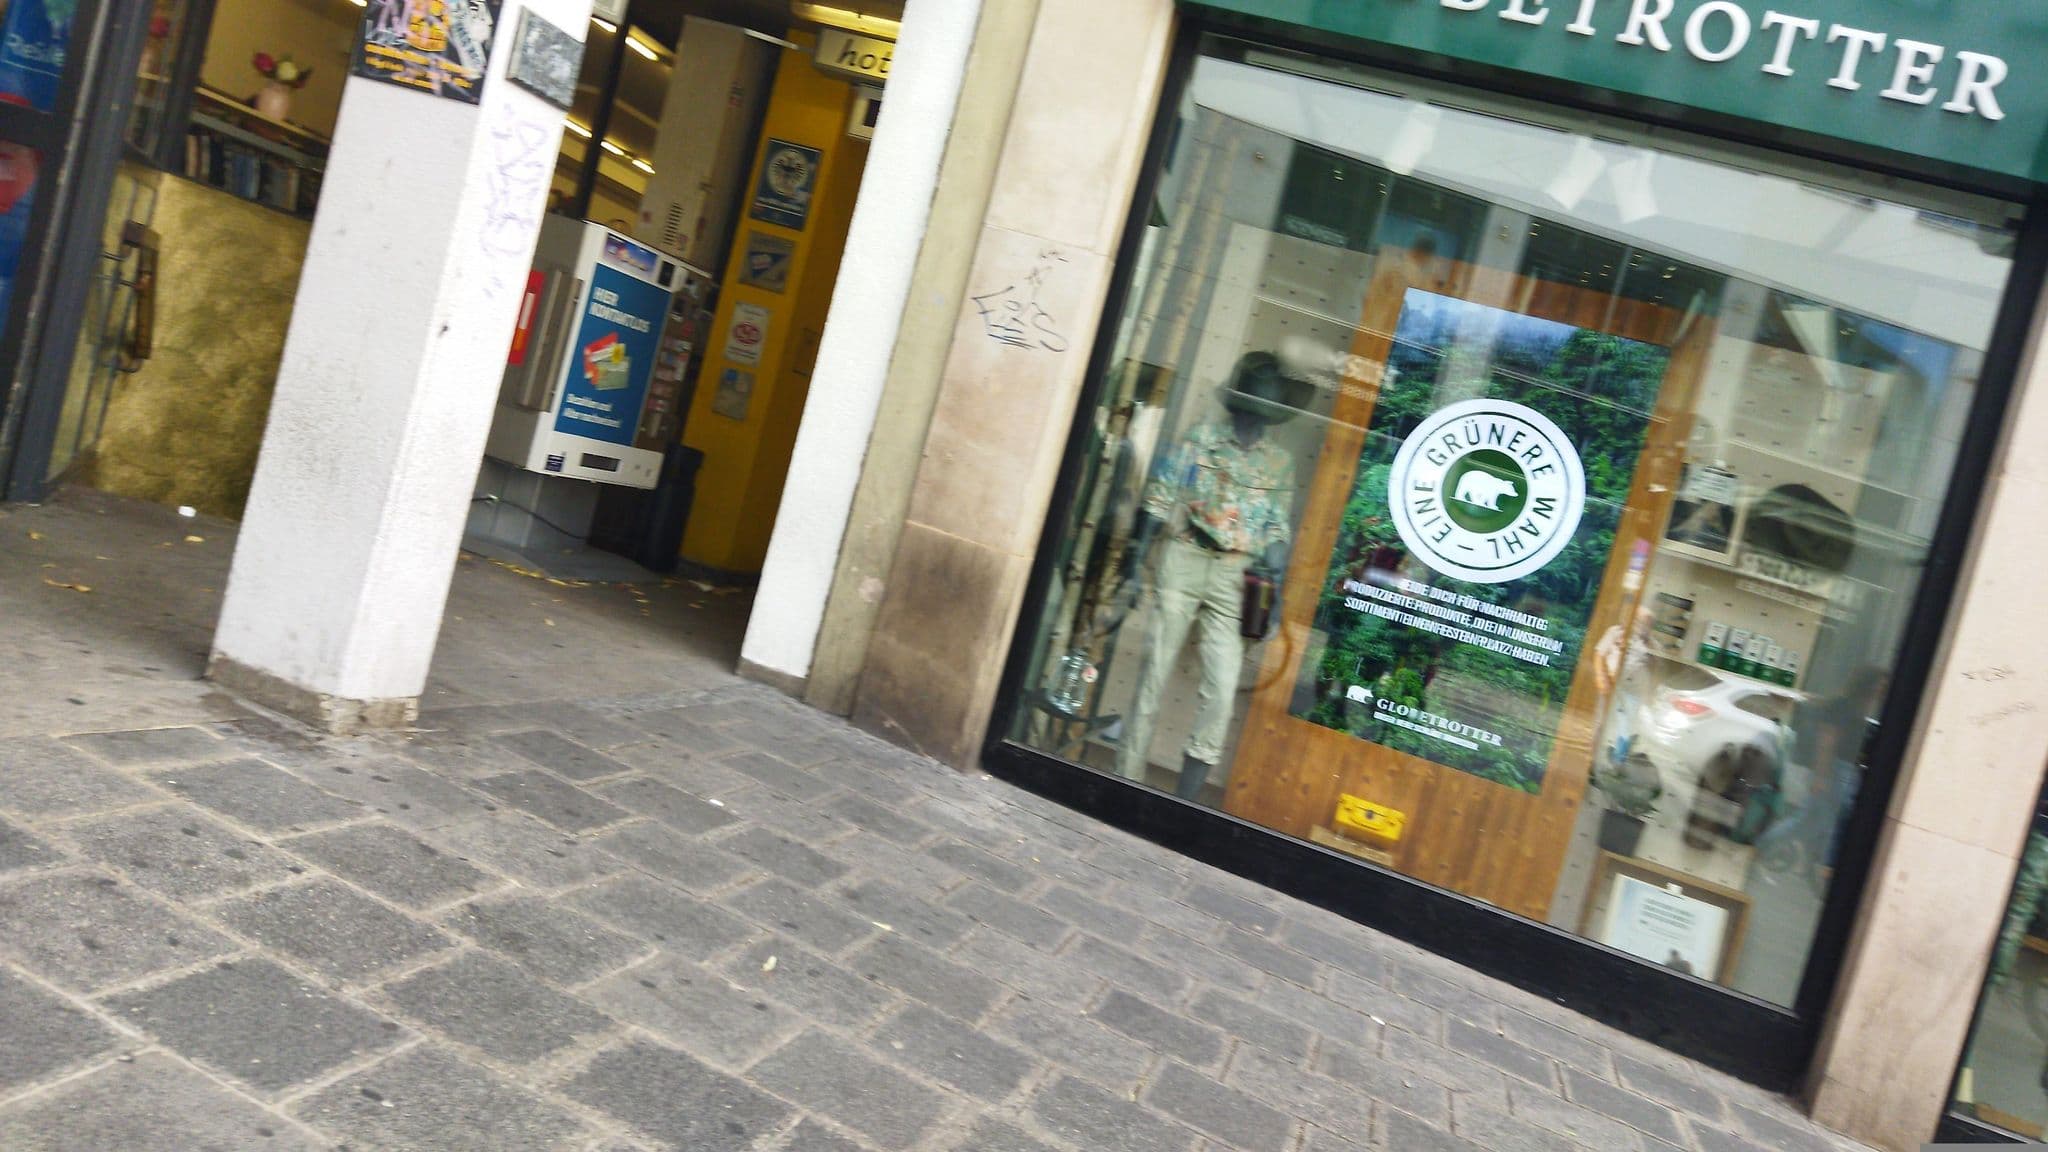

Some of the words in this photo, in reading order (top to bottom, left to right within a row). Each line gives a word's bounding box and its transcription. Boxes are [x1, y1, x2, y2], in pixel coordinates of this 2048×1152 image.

[1438, 0, 2008, 120] ROTTER
[1426, 419, 1555, 480] GRÜNERE
[1414, 479, 1453, 543] EINE
[1487, 496, 1557, 559] WAHL
